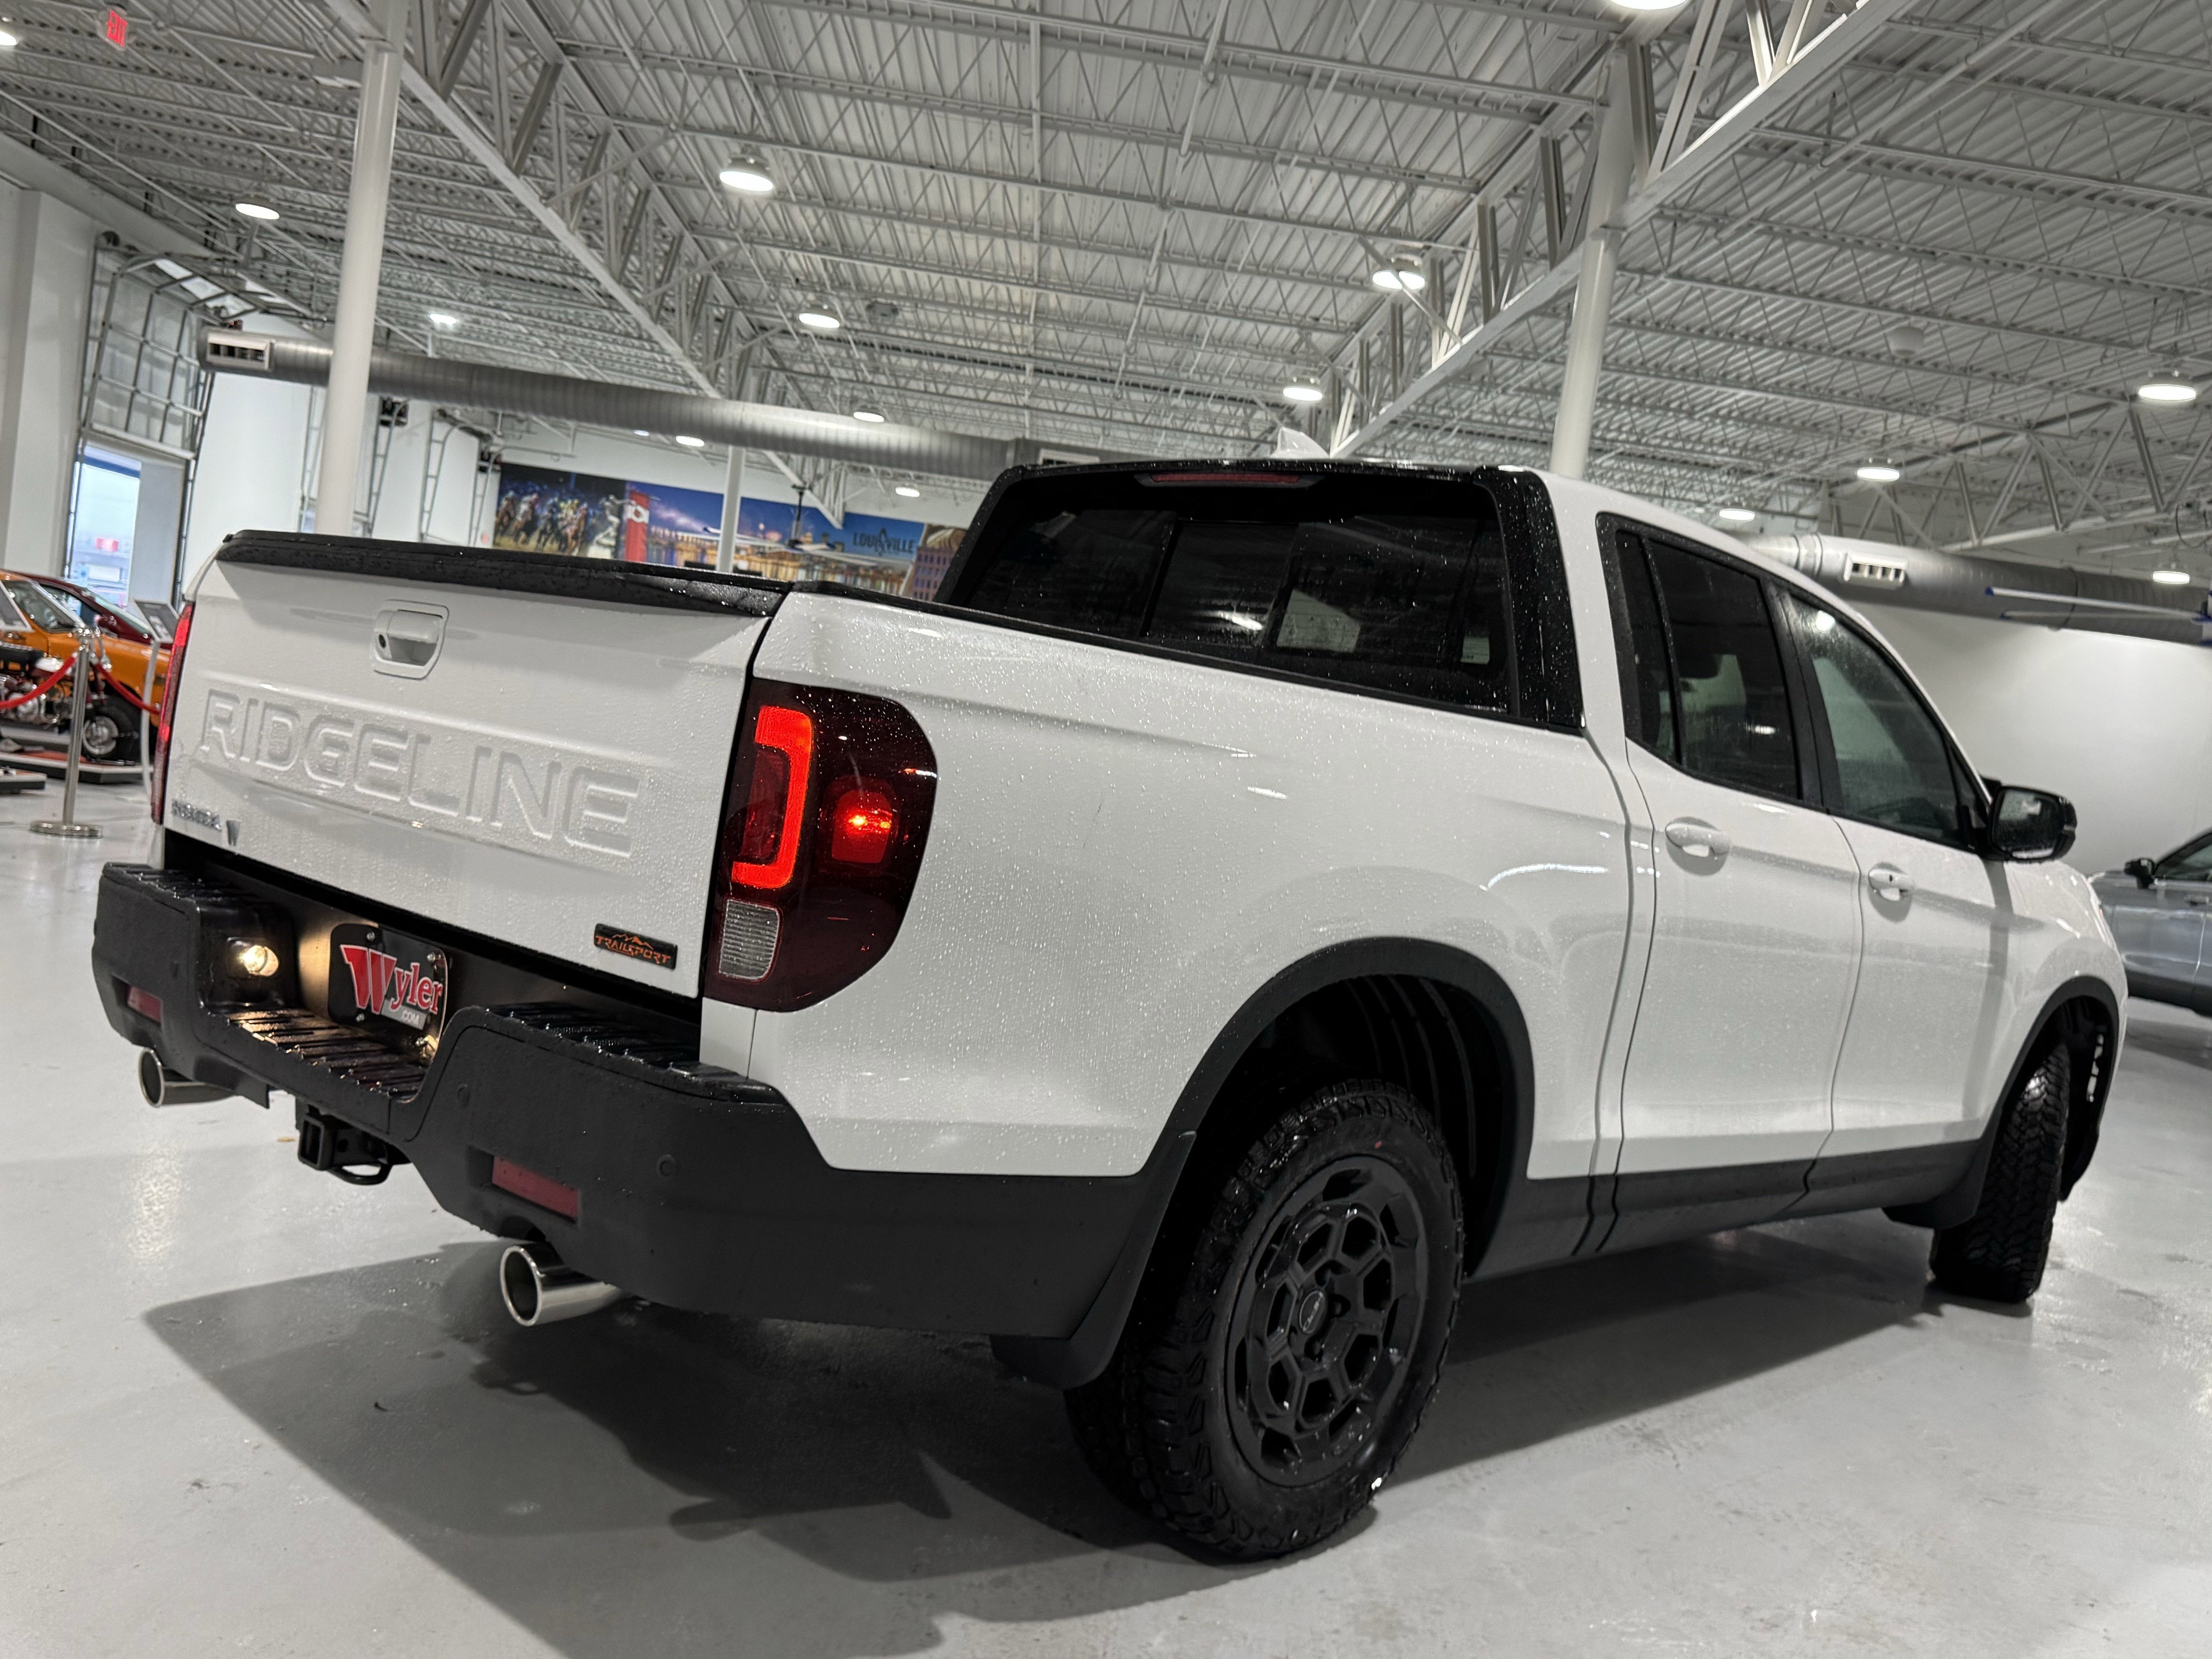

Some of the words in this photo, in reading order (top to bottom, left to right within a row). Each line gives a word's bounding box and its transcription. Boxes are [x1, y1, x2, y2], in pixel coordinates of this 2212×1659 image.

[200, 688, 641, 858] RIDGELINE
[340, 944, 443, 1015] Wyler
[595, 935, 671, 964] TRAILSPORT
